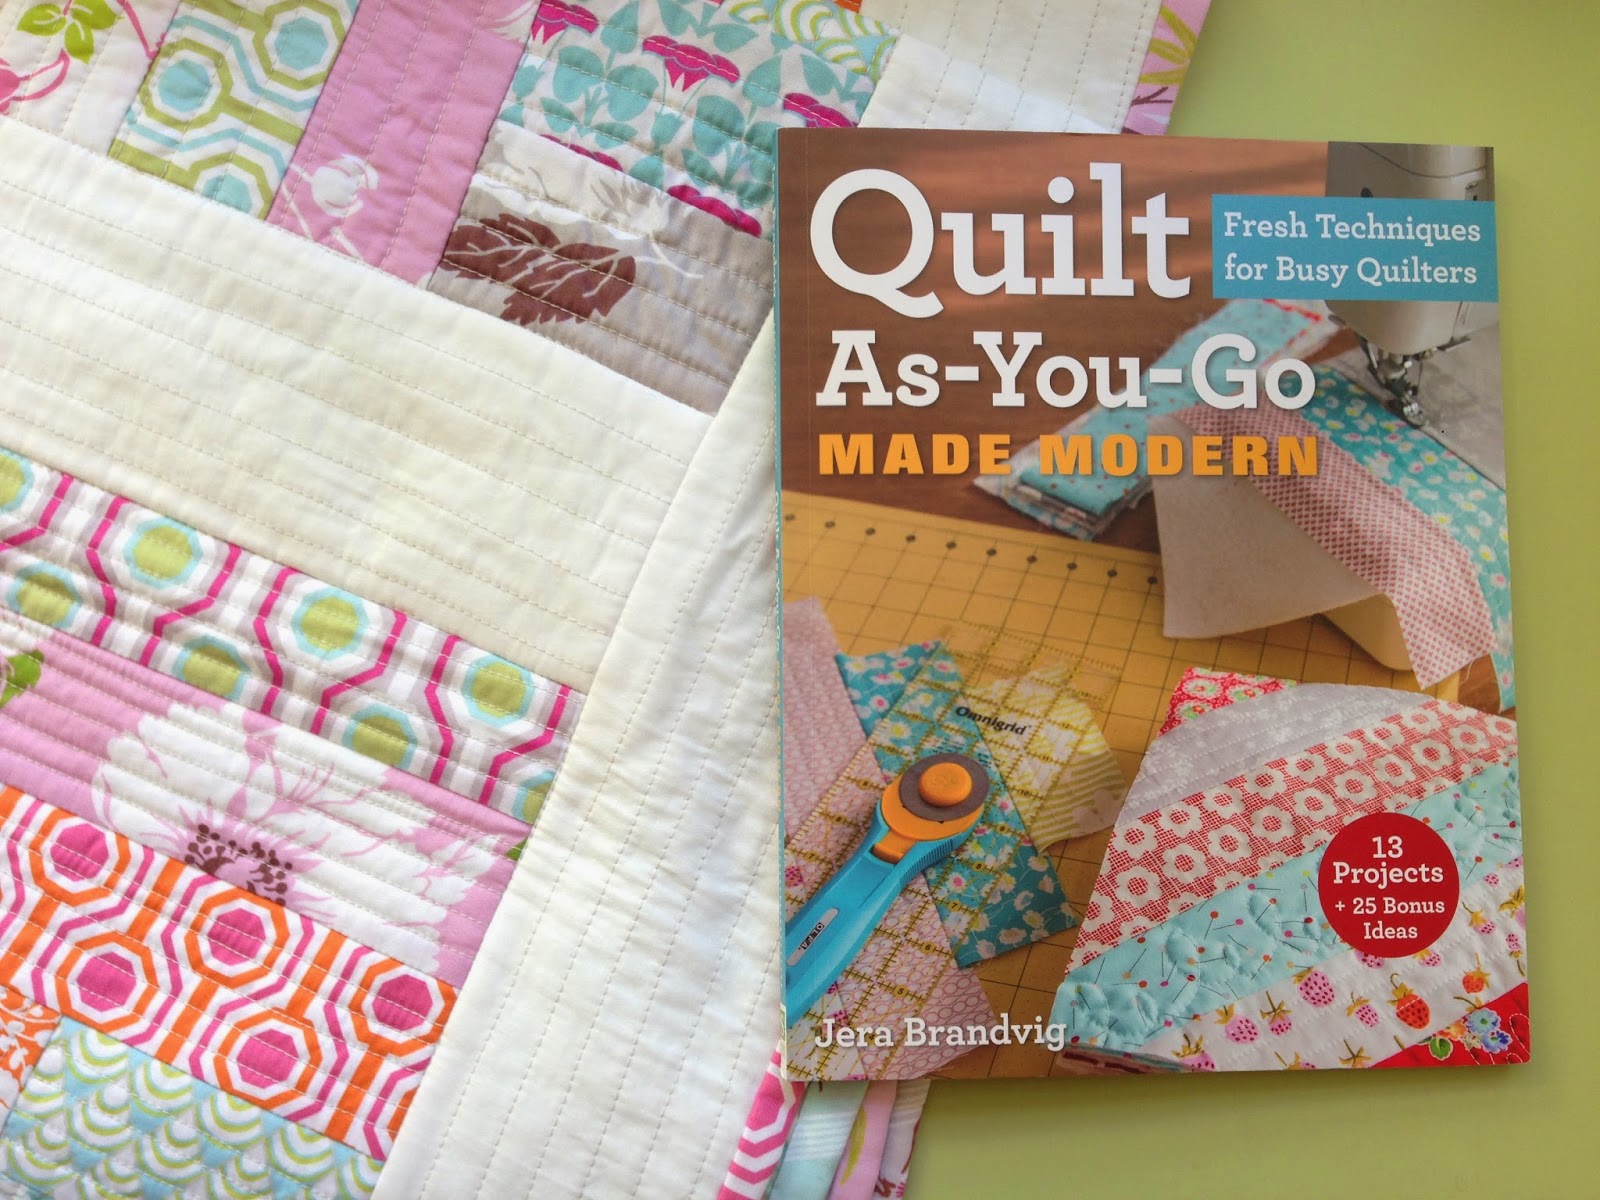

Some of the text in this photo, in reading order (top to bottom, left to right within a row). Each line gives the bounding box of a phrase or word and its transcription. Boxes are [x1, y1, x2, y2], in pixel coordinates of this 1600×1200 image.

[809, 162, 1191, 319] Quilt
[1224, 210, 1482, 247] Fresh Techniques
[1224, 252, 1478, 289] for Busy Quilters
[815, 330, 1316, 410] As-You-Go
[818, 433, 1319, 477] MADE MODERN
[955, 705, 1027, 736] Omnigrid
[1372, 835, 1404, 859] 13
[1333, 861, 1444, 889] Projects
[1335, 896, 1445, 915] + 25 Bonus
[801, 921, 825, 951] OLFA
[1363, 920, 1418, 940] Ideas
[814, 1013, 1067, 1051] Jera Brandvig
